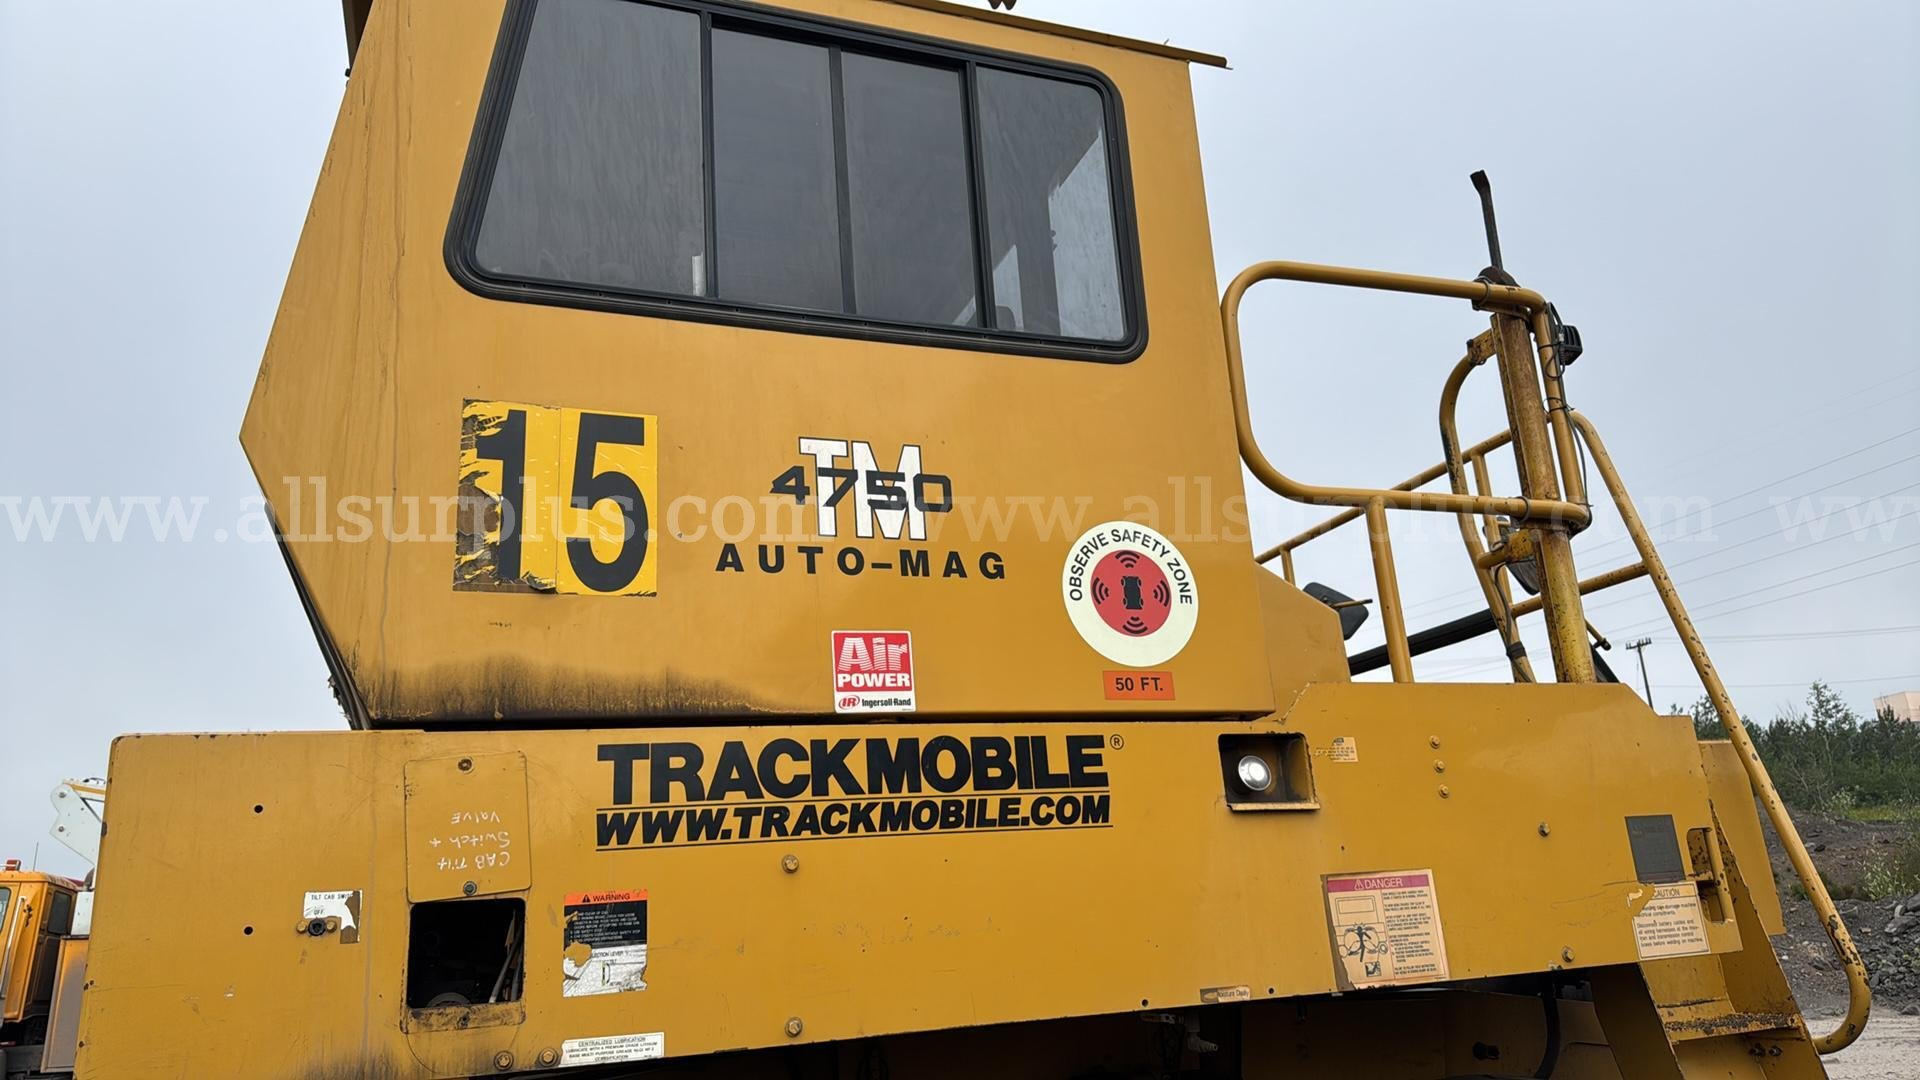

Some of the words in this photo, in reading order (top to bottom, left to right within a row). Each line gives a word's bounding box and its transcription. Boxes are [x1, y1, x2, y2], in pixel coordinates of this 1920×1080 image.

[476, 409, 648, 592] 15
[770, 466, 953, 512] 4750
[715, 543, 1006, 579] AUTO-MAG
[1069, 532, 1109, 601] OBSERVE
[1111, 529, 1170, 558] SAFETY
[1167, 558, 1192, 605] ZONE
[838, 637, 908, 671] Air
[837, 673, 910, 688] POWER
[1115, 677, 1134, 692] 50
[1140, 677, 1163, 692] FT.
[596, 795, 1110, 846] WWW.TRACKMOBILE.COM
[449, 831, 511, 848] Switch
[475, 851, 511, 870] CAB
[1364, 878, 1404, 889] DANGER
[593, 893, 631, 902] WARNING
